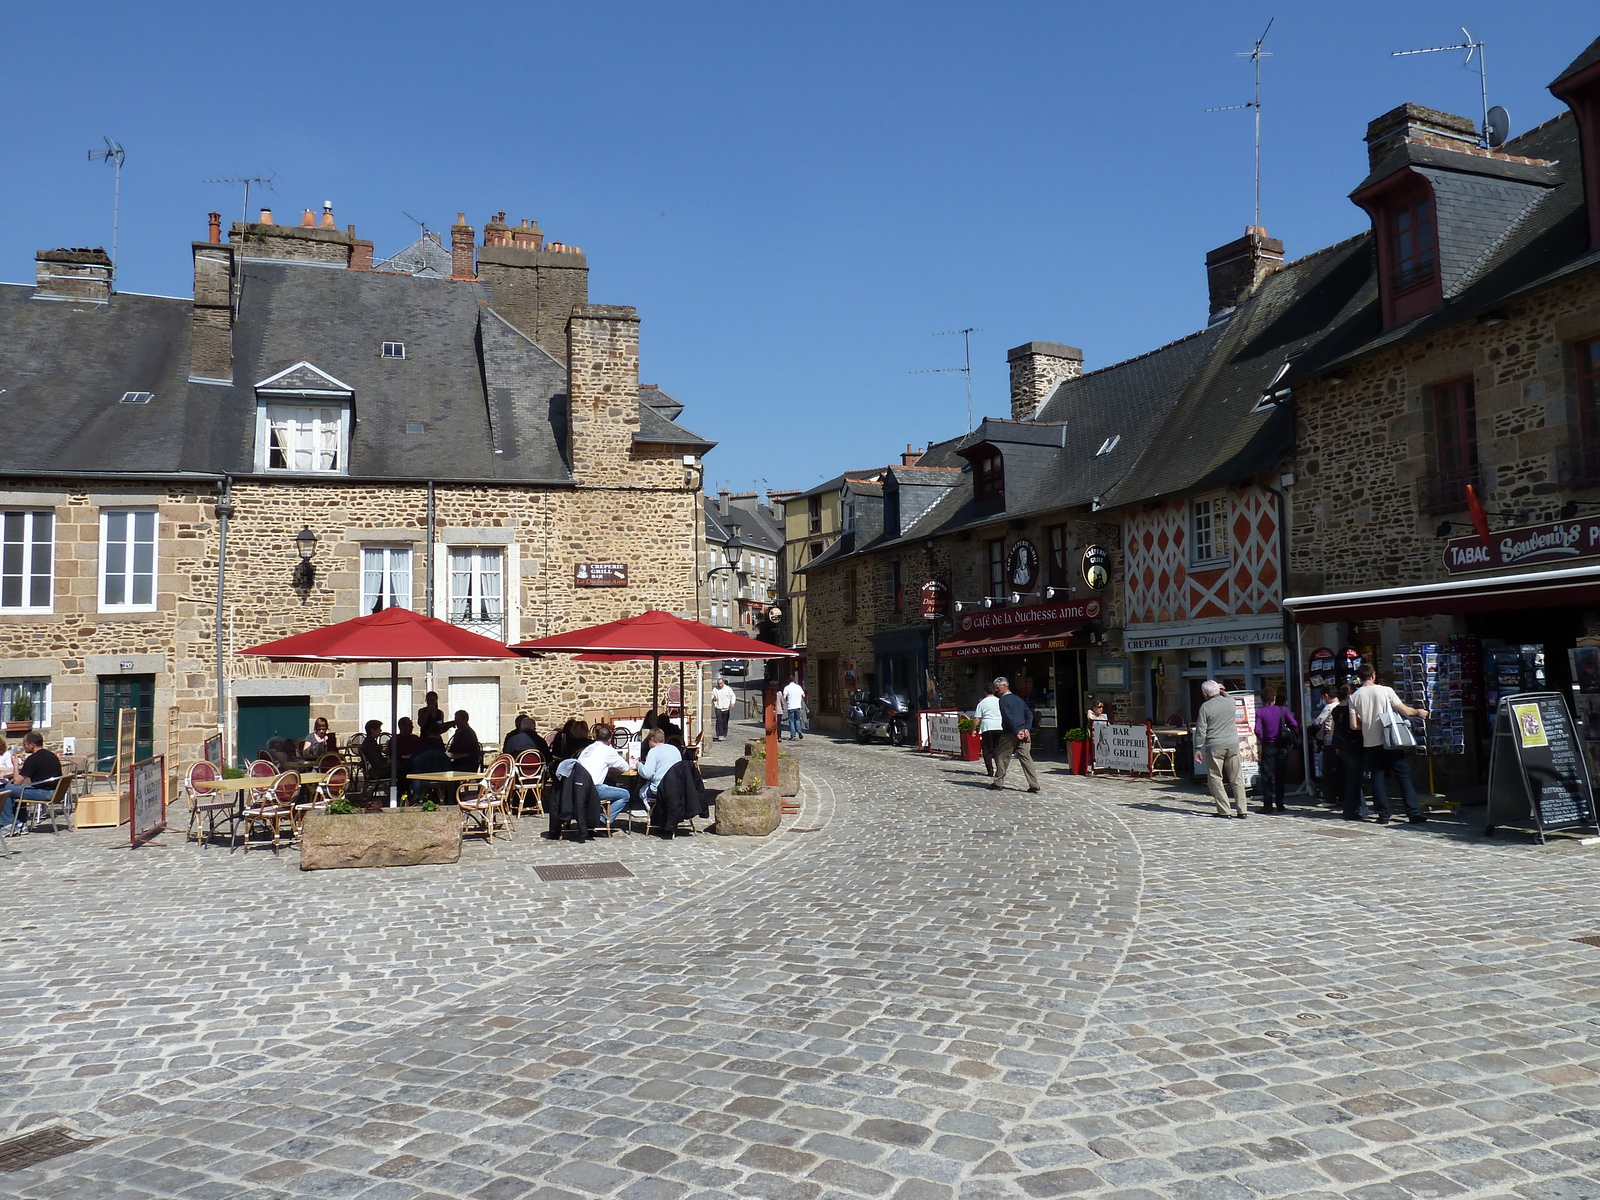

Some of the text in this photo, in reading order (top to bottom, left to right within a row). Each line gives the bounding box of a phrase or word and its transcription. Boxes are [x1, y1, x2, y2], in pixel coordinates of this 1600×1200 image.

[1450, 524, 1600, 566] TABAC Souvenirs P
[1048, 640, 1065, 648] AMSTEL
[1127, 638, 1170, 649] CREPERIE
[1179, 637, 1194, 647] La
[1197, 632, 1249, 645] Duchesse
[1112, 727, 1130, 736] BAR
[1112, 738, 1147, 748] CREPERIE
[1113, 748, 1139, 759] GRILL
